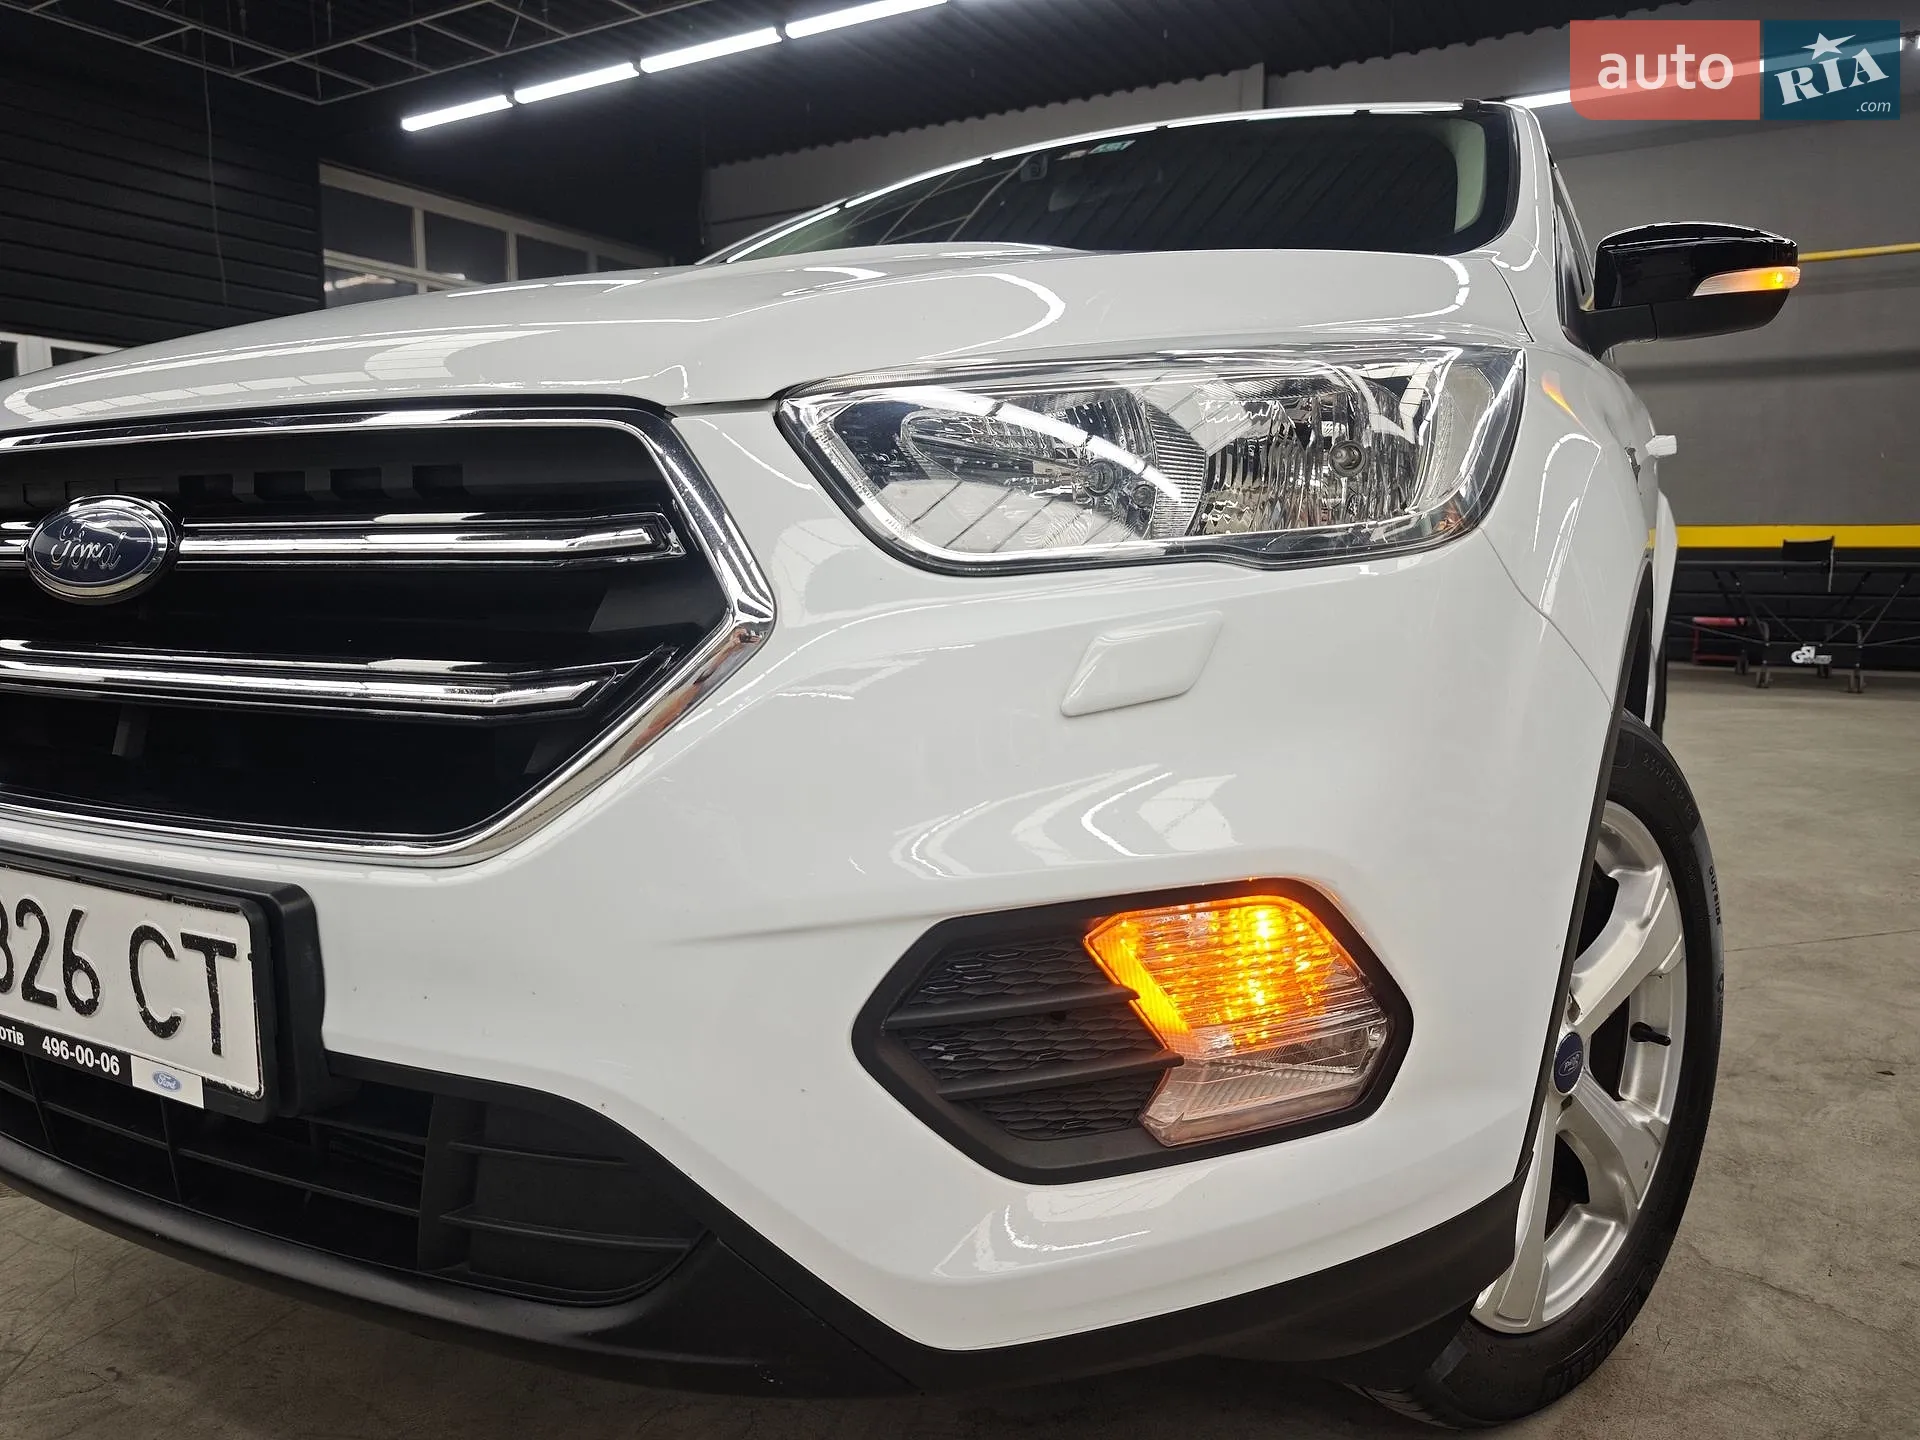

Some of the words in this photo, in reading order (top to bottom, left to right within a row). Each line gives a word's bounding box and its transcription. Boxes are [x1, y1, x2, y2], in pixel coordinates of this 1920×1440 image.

[50, 523, 126, 570] Ford
[129, 924, 238, 1056] CT
[42, 1035, 120, 1076] 496-00-06
[157, 1072, 177, 1090] Ford
